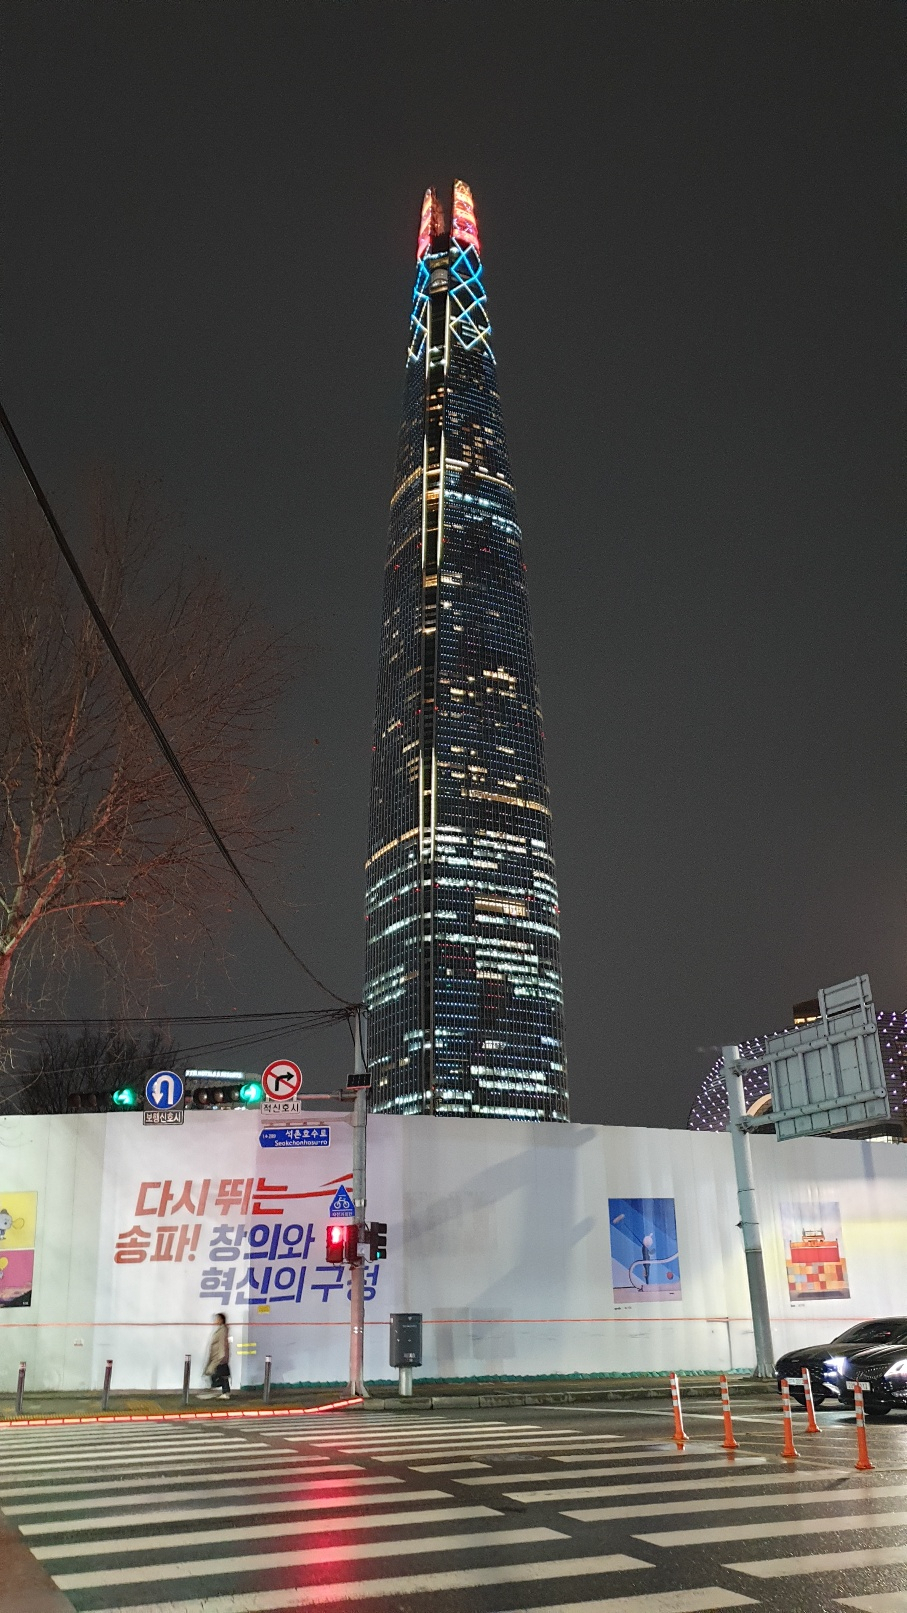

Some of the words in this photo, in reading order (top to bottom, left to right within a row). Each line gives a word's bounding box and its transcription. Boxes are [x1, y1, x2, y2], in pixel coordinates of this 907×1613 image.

[263, 1102, 299, 1113] 적신호시
[145, 1111, 181, 1123] 보행신호시
[285, 1129, 328, 1140] 석촌호수로
[274, 1139, 328, 1147] Seokchonhosu-ro
[134, 1178, 211, 1217] 다시
[214, 1177, 297, 1216] 뛰는
[114, 1224, 202, 1264] 송파!
[209, 1223, 315, 1262] 창의와
[199, 1266, 307, 1306] 혁신의
